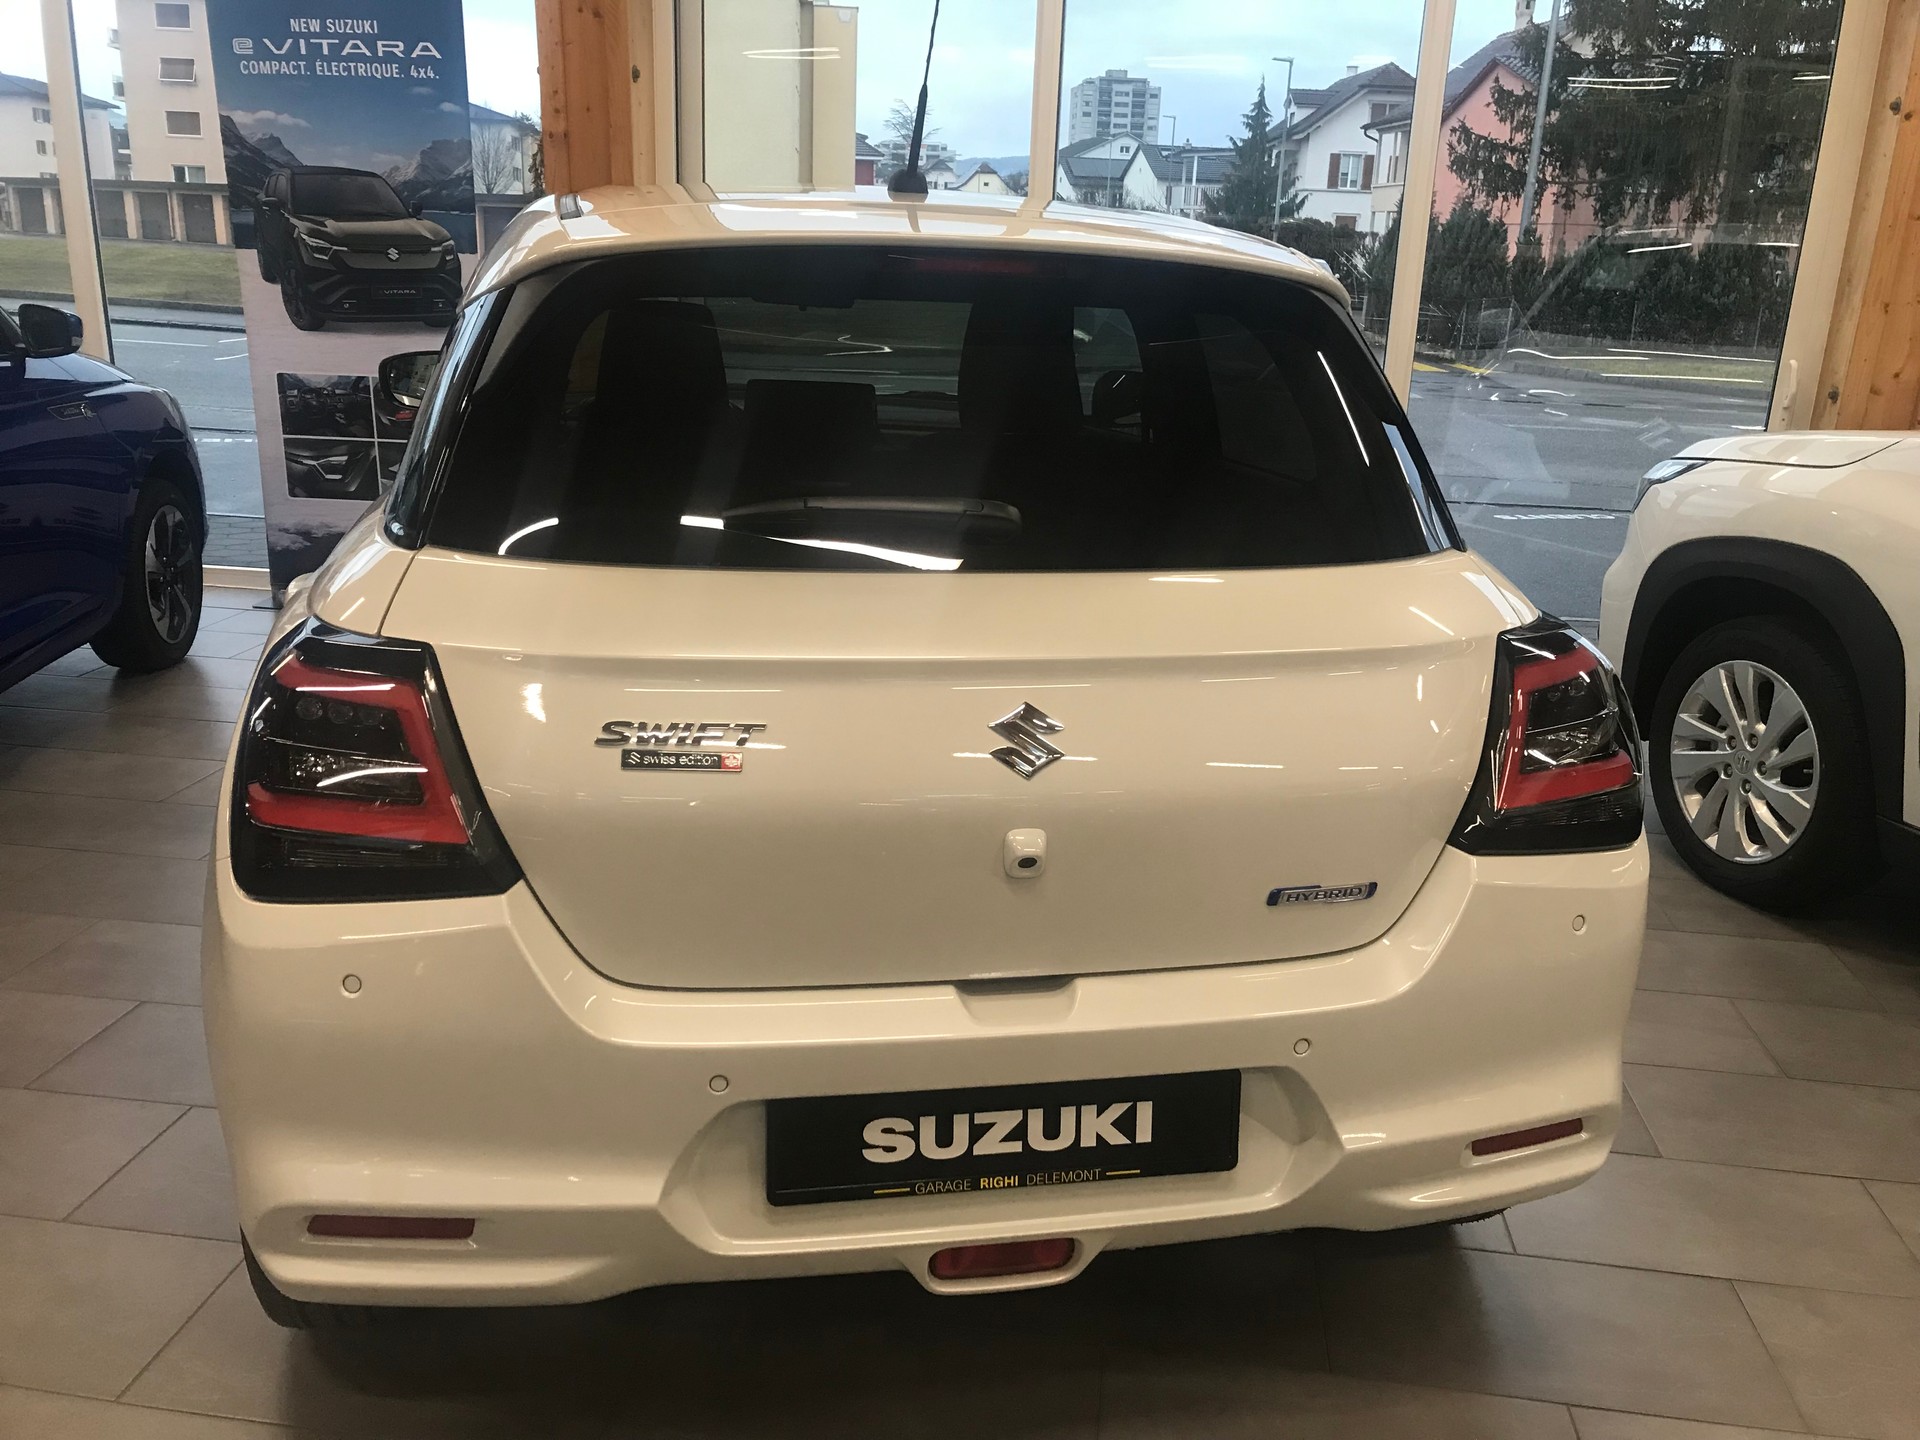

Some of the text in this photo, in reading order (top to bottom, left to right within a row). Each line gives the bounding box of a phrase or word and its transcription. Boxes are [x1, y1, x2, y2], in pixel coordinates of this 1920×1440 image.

[290, 19, 378, 34] NEW SUZUKI
[262, 38, 442, 59] VITARA
[240, 59, 439, 79] COMPACT. ÉLECTRIQUE. 4x4.
[594, 720, 767, 747] SWIFT
[643, 753, 718, 767] swiss edition
[1285, 887, 1362, 902] HYBRID
[862, 1101, 1153, 1164] SUZUKI
[915, 1168, 1101, 1195] GARAGE RIGHI DELEMONT
